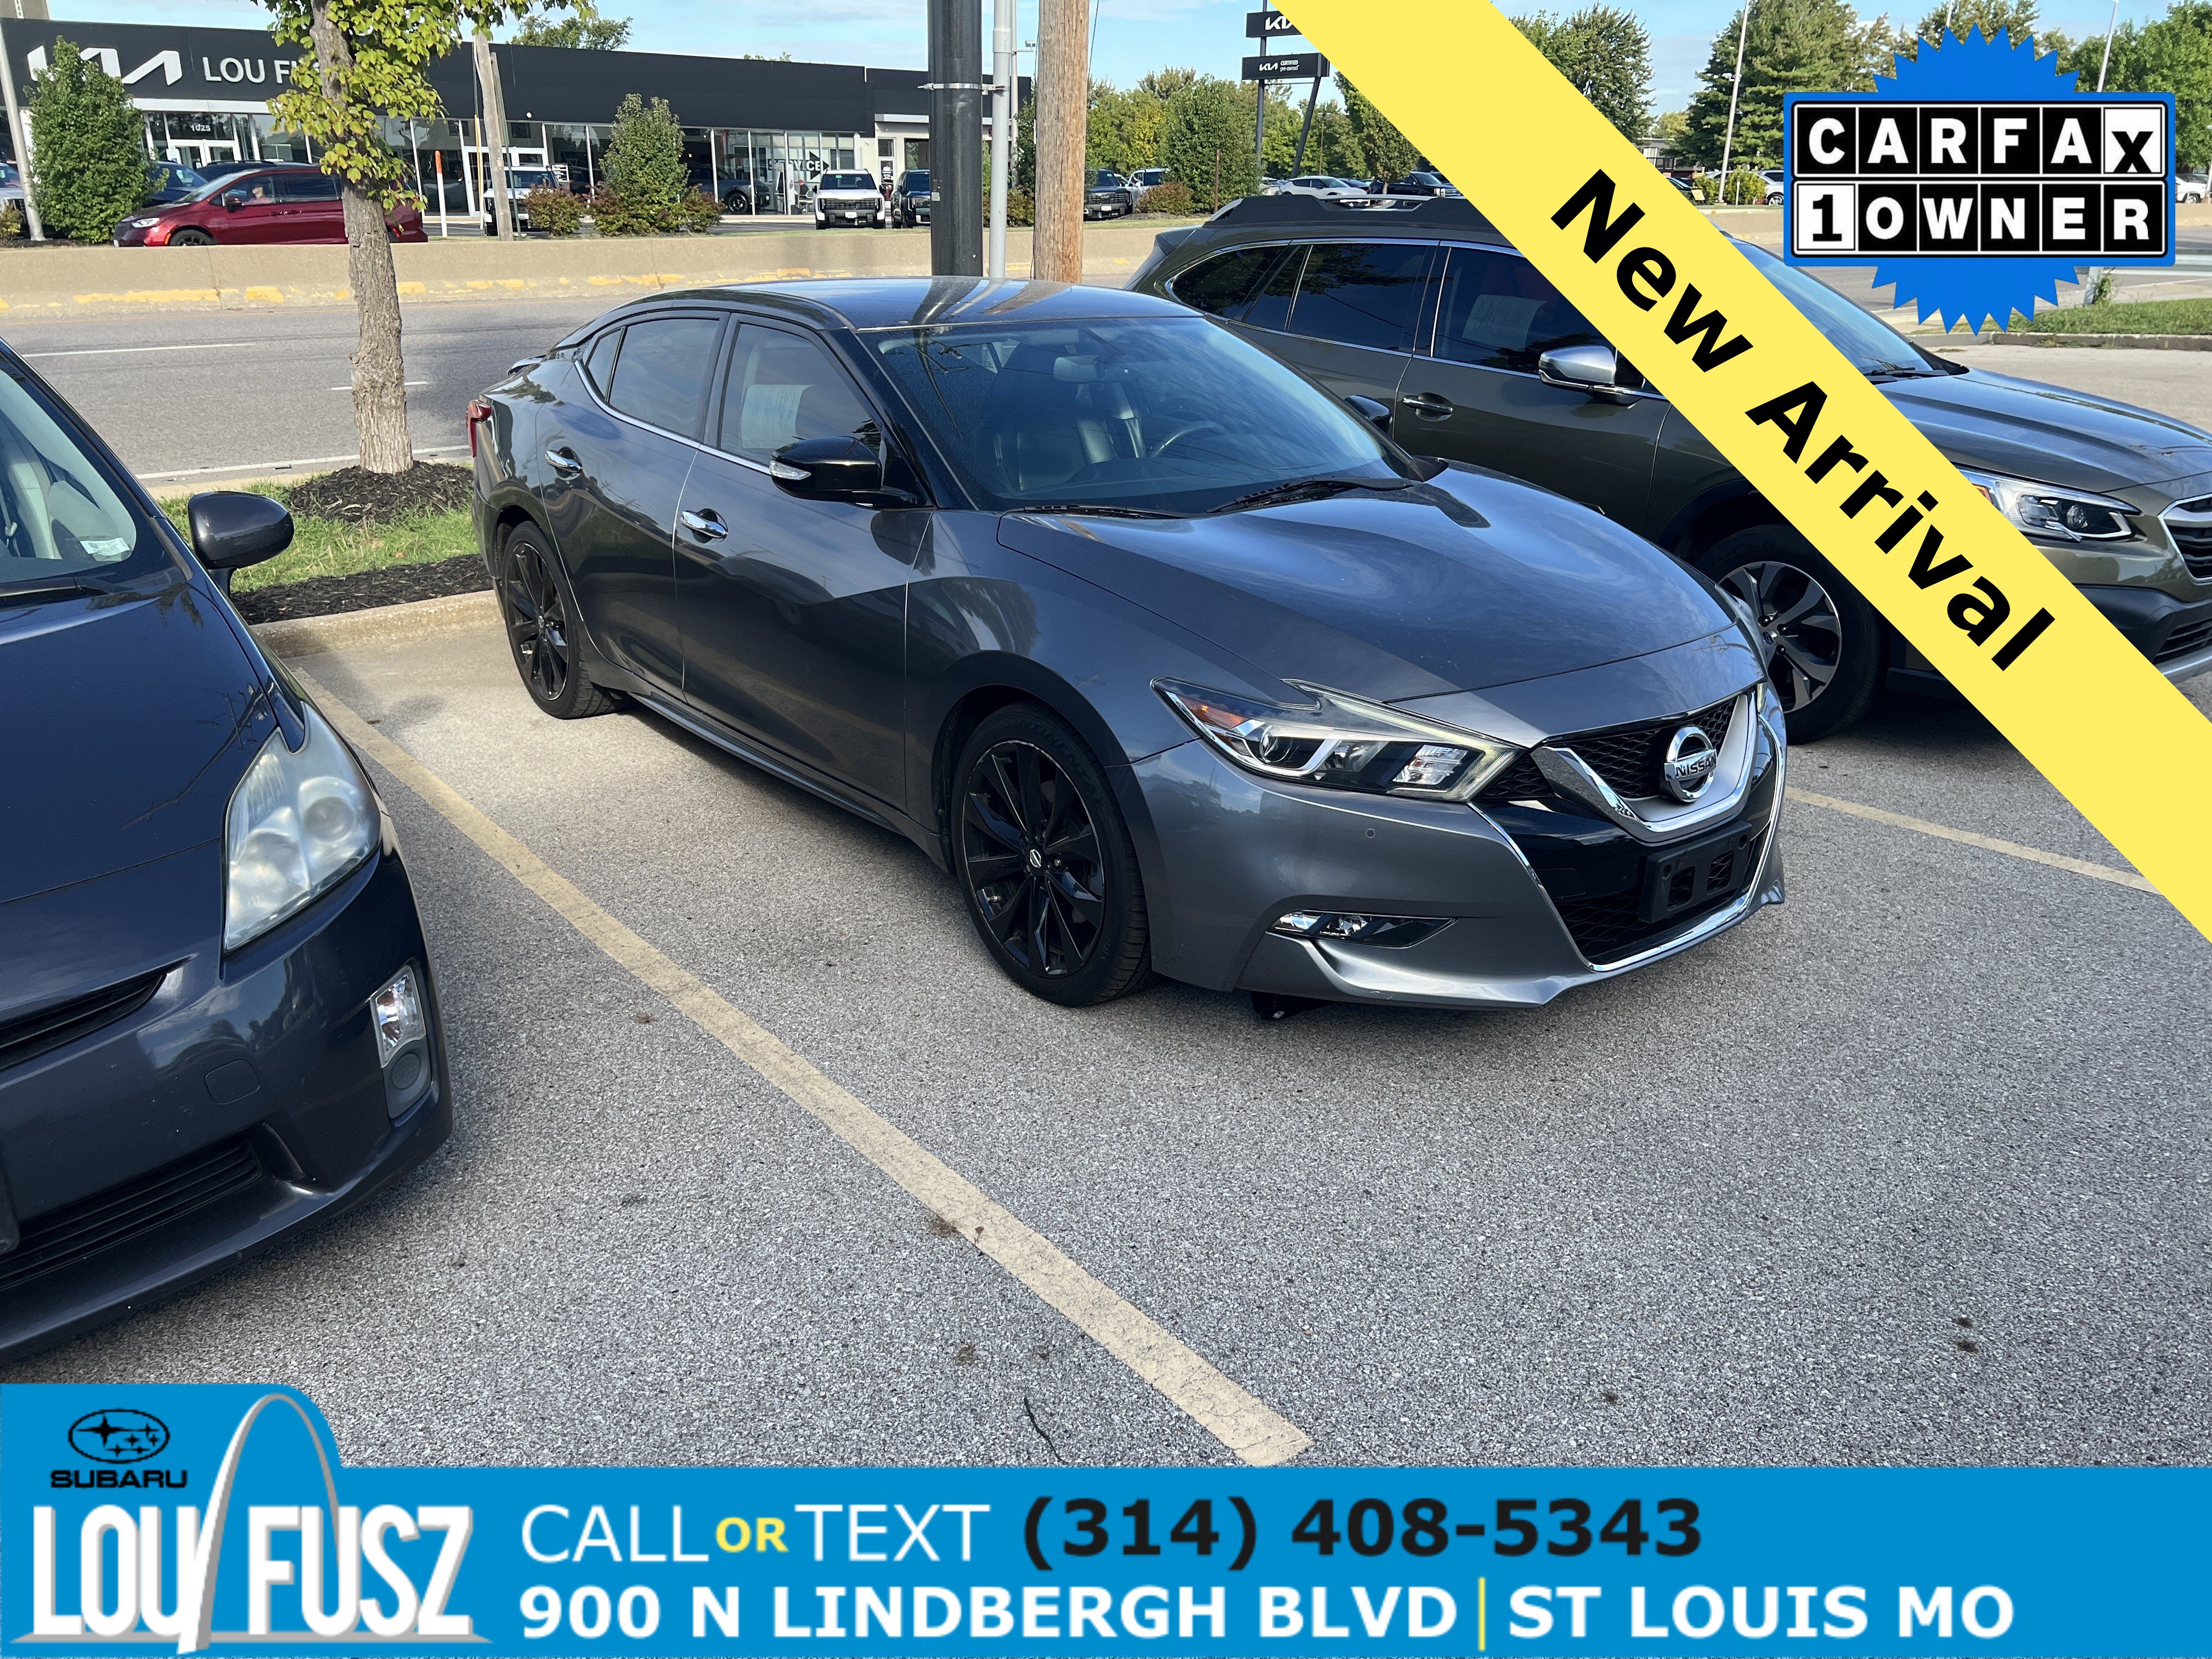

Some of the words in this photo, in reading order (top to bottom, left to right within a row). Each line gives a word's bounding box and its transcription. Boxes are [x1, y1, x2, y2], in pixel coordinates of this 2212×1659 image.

[1265, 15, 1293, 30] KI
[202, 57, 266, 83] LOU
[190, 123, 211, 132] 1025
[769, 160, 821, 171] SVCE
[1675, 756, 1716, 777] NISSAN
